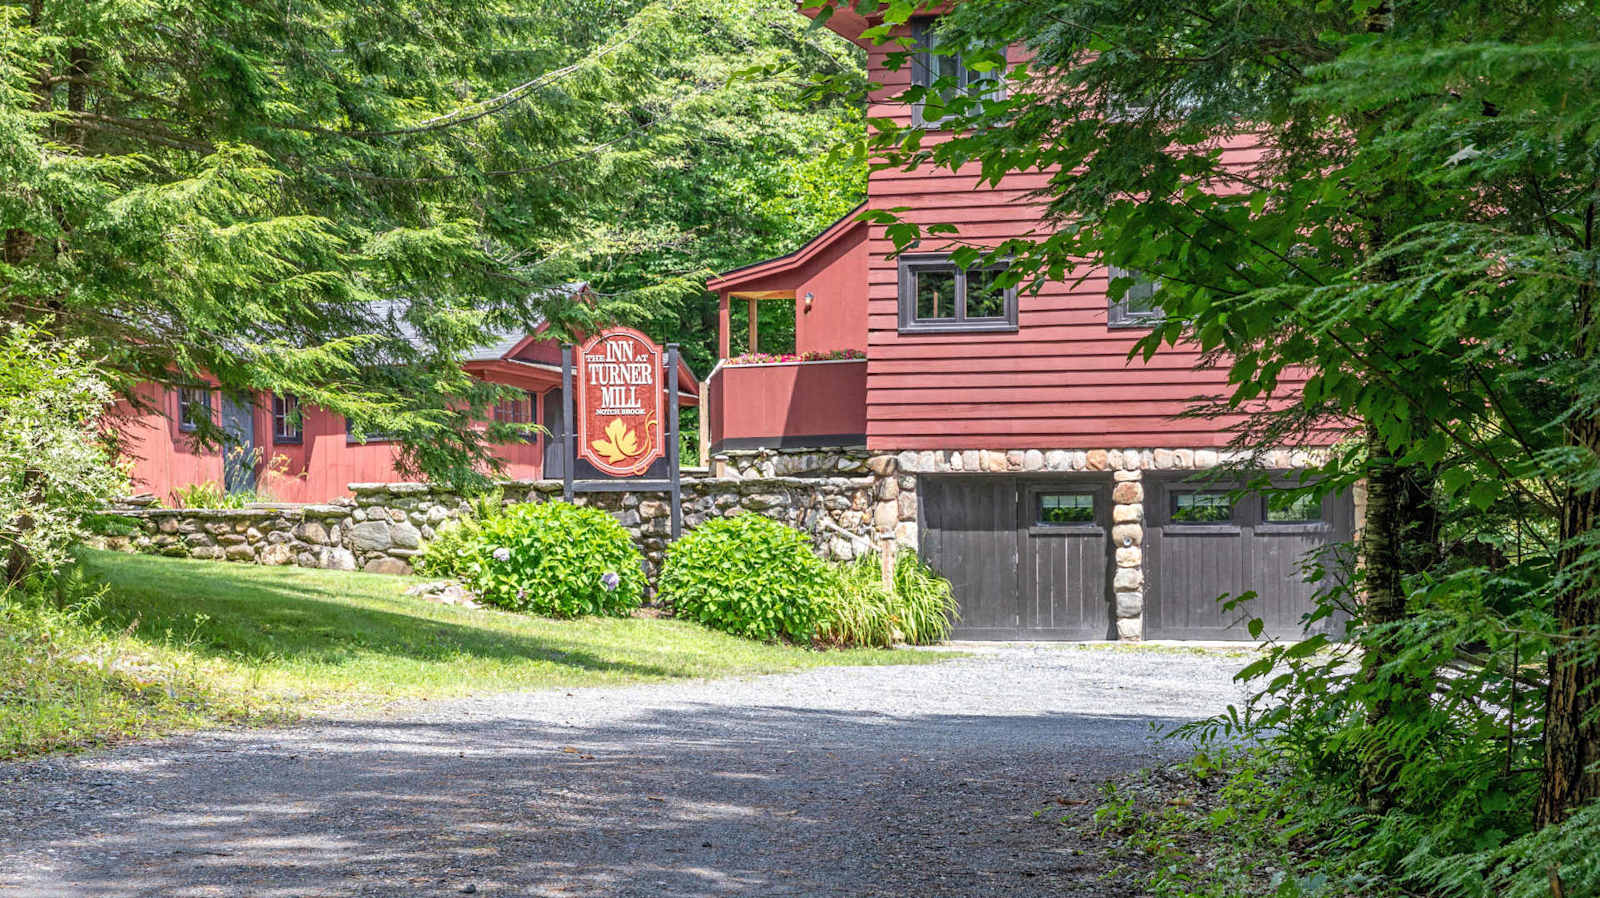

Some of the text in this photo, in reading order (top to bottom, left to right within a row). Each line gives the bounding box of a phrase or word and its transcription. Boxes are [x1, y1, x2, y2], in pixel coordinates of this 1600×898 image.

[586, 340, 648, 362] THE INN AT
[588, 363, 653, 385] TURNER
[601, 386, 641, 408] MILL
